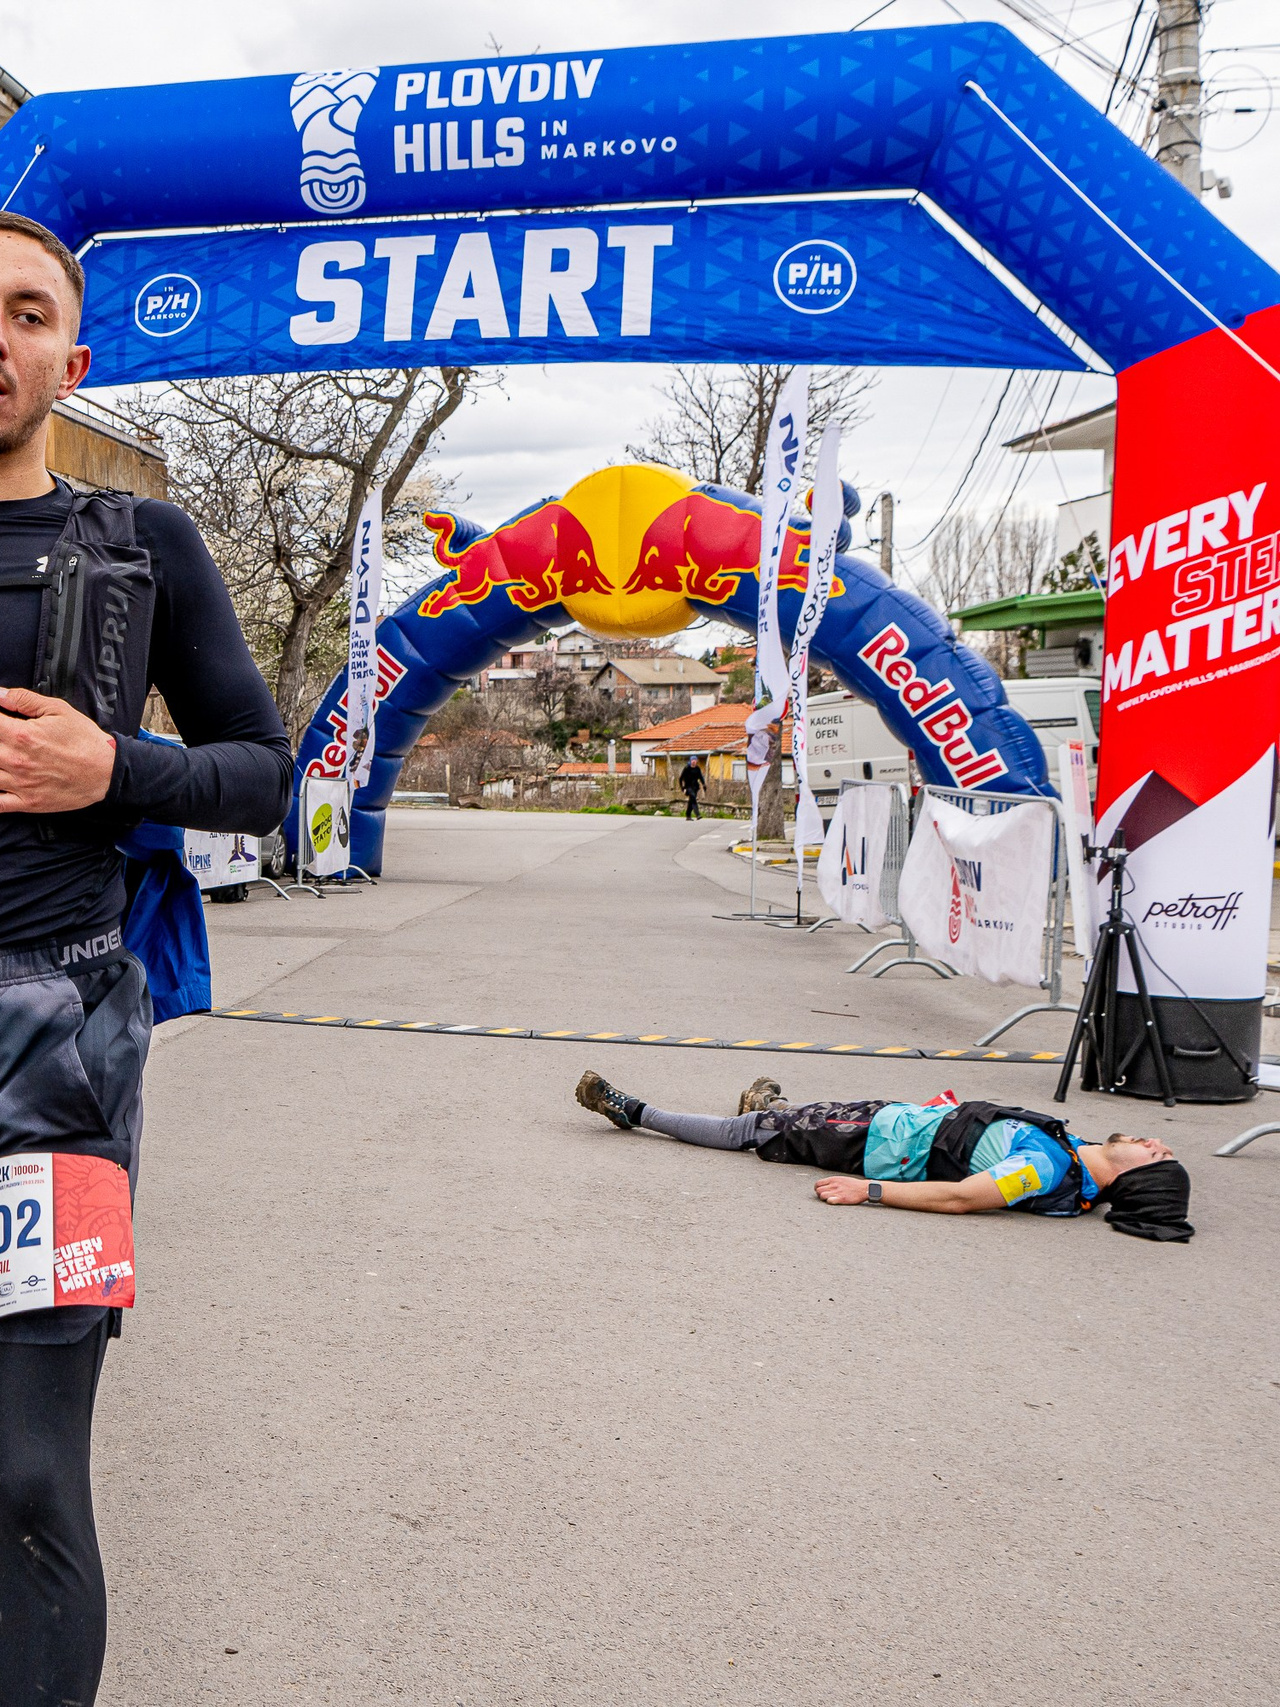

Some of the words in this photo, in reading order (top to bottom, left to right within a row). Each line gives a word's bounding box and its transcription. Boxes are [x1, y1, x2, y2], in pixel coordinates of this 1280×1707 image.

[394, 58, 604, 112] PLOVDIV
[541, 119, 568, 138] IN
[393, 116, 525, 174] HILLS
[541, 136, 678, 160] MARKOVO
[809, 254, 821, 262] IN
[289, 225, 673, 346] START
[788, 262, 842, 288] P/H
[146, 292, 190, 315] P/H
[787, 288, 842, 296] MARKOVO
[143, 312, 187, 321] MARKOVO
[1107, 482, 1267, 599] EVERY
[354, 519, 371, 625] DEVIN
[1171, 530, 1280, 617] STE
[96, 563, 138, 715] KIPRUN
[810, 715, 844, 726] KACHEL
[862, 627, 950, 713] Red
[923, 703, 1003, 789] Bull
[807, 743, 848, 756] LEITER
[1155, 921, 1203, 930] STUDIO
[60, 925, 122, 966] UNDE
[53, 1236, 103, 1265] EVERY
[55, 1253, 97, 1279] STEP
[59, 1260, 133, 1293] MATTERS
